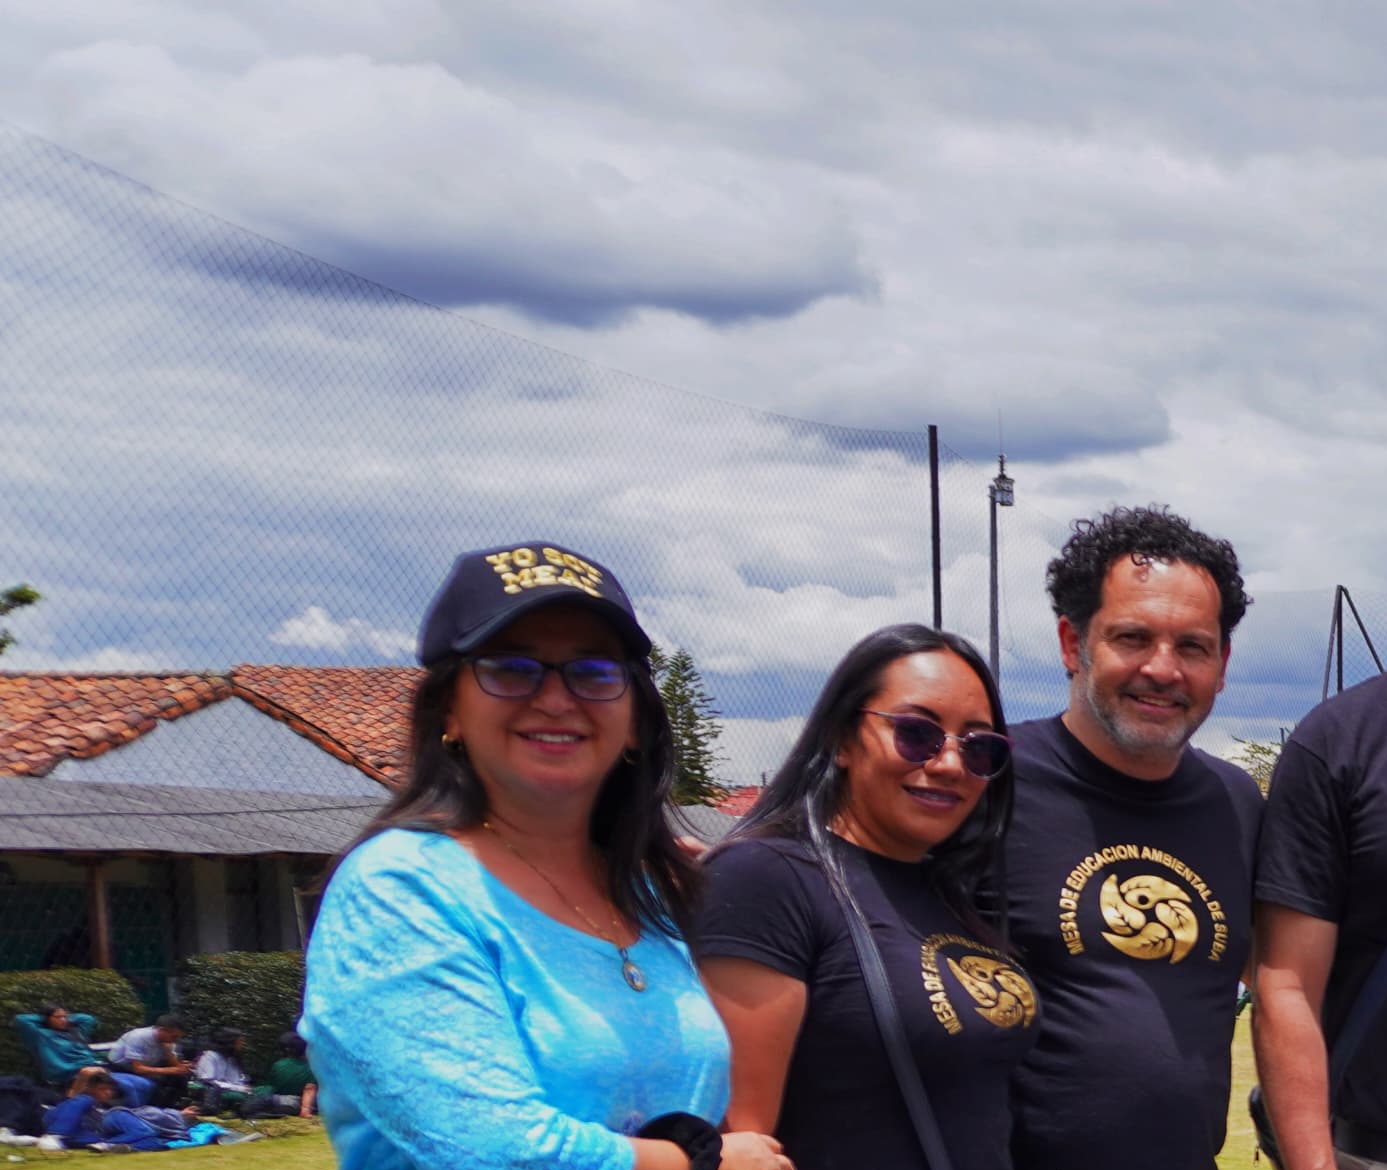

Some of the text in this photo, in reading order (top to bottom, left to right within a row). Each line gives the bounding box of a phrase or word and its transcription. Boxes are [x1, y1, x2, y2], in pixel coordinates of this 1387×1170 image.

[485, 547, 538, 574] YO
[1066, 844, 1139, 891] EDUCACION
[1141, 845, 1213, 901] AMBIENTAL
[1059, 888, 1081, 912] DE
[1207, 900, 1226, 921] DE
[1059, 911, 1085, 955] MESA
[1208, 922, 1229, 962] SUBA
